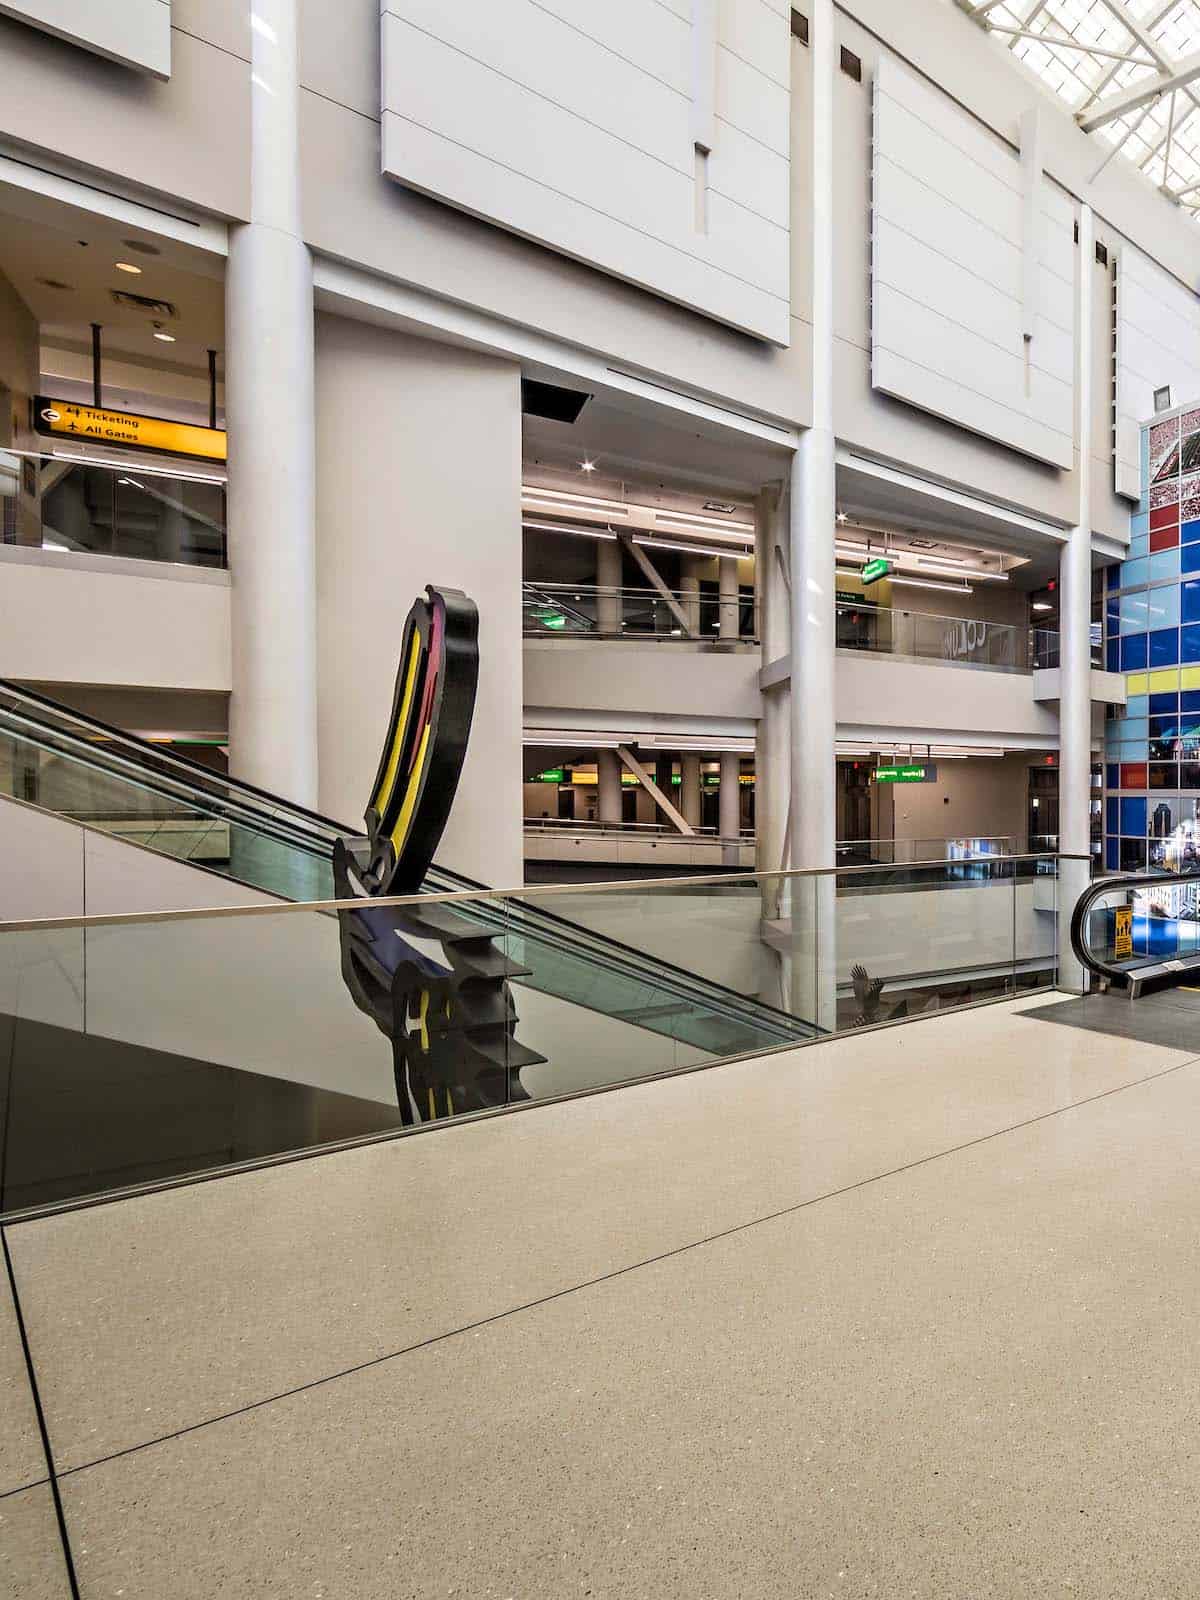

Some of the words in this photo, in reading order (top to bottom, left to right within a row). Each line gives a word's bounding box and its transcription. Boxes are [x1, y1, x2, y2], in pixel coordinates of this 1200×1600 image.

[86, 411, 139, 428] Ticketing
[86, 425, 102, 435] All
[105, 429, 138, 440] Gates
